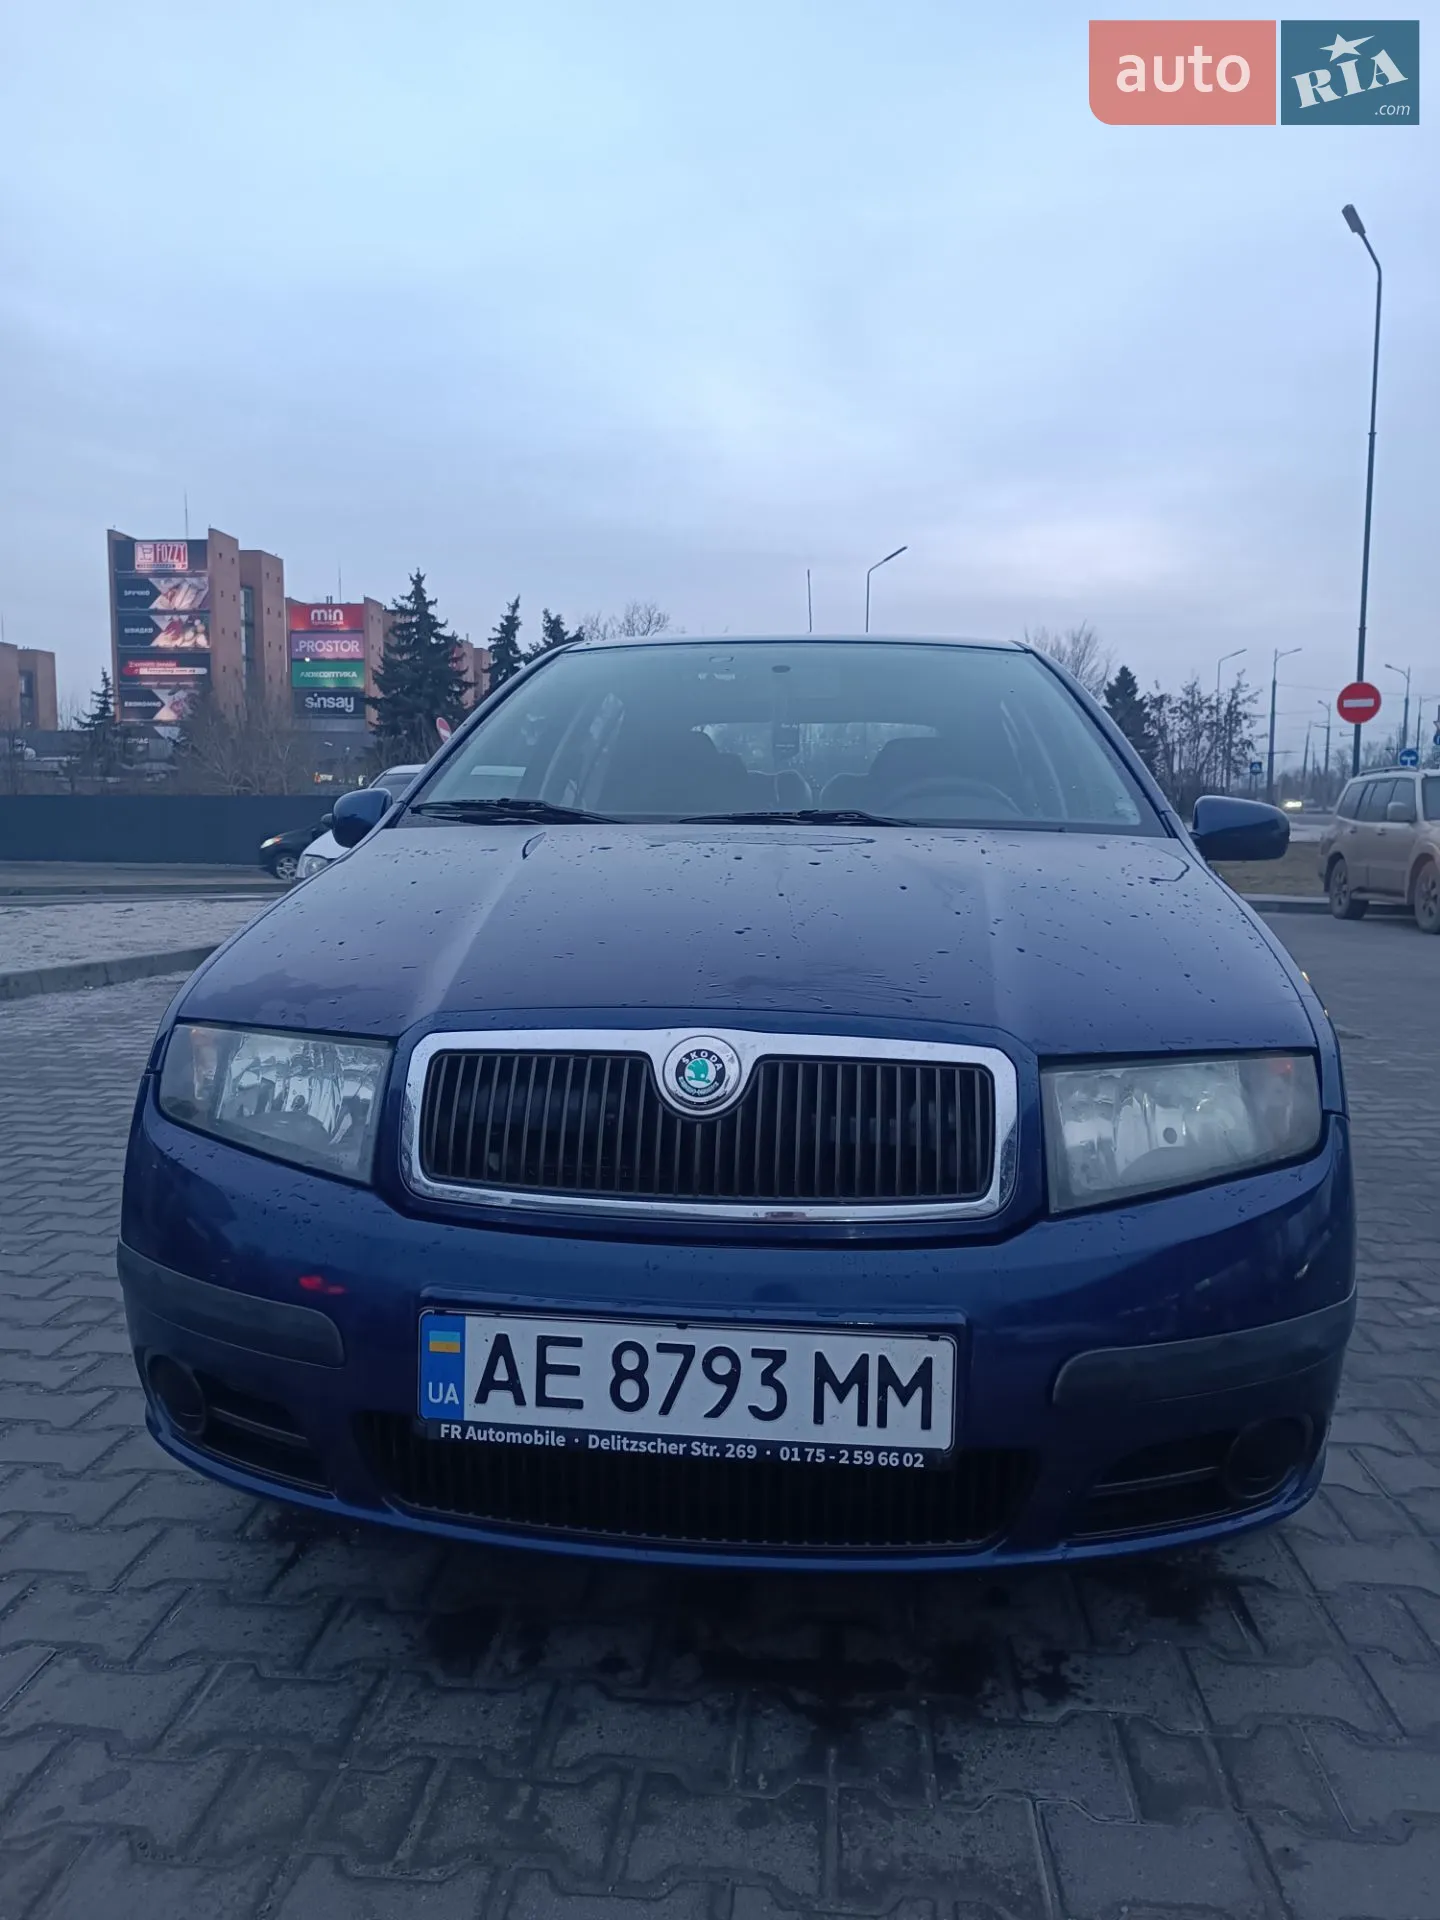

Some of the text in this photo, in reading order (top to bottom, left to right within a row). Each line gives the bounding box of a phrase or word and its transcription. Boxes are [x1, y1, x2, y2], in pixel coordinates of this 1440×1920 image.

[156, 543, 187, 563] FOZZY
[427, 1381, 460, 1405] UA
[474, 1332, 933, 1431] AE 8793 MM
[439, 1423, 463, 1440] FR
[464, 1425, 567, 1447] Automobile
[587, 1434, 688, 1456] Delitzscher
[690, 1440, 721, 1459] Str.
[724, 1443, 758, 1460] 269
